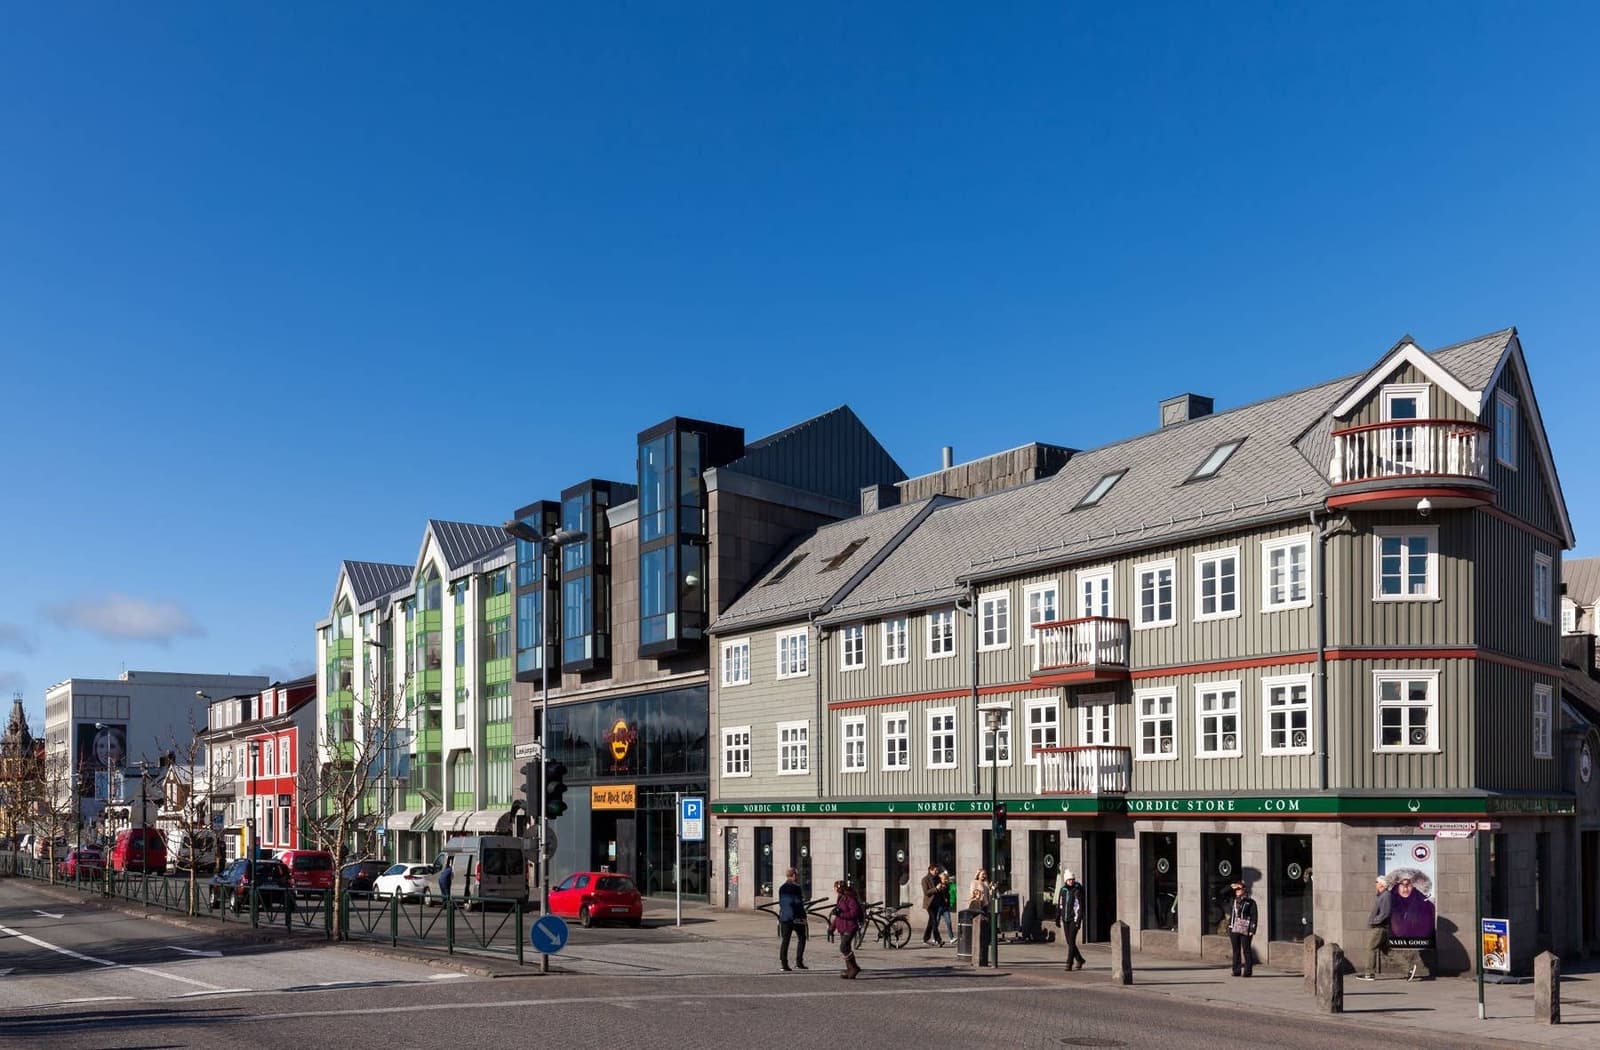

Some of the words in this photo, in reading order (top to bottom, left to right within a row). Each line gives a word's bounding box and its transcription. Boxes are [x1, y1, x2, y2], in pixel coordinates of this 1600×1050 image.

[593, 791, 606, 803] Hard
[607, 791, 620, 804] Rock
[621, 790, 633, 804] Cafe
[743, 804, 771, 813] NORDIC
[781, 803, 806, 812] STORE
[917, 803, 956, 812] NORDIC
[1126, 800, 1179, 811] NORDIC
[1187, 800, 1235, 811] STORE
[1258, 800, 1300, 811] .COM
